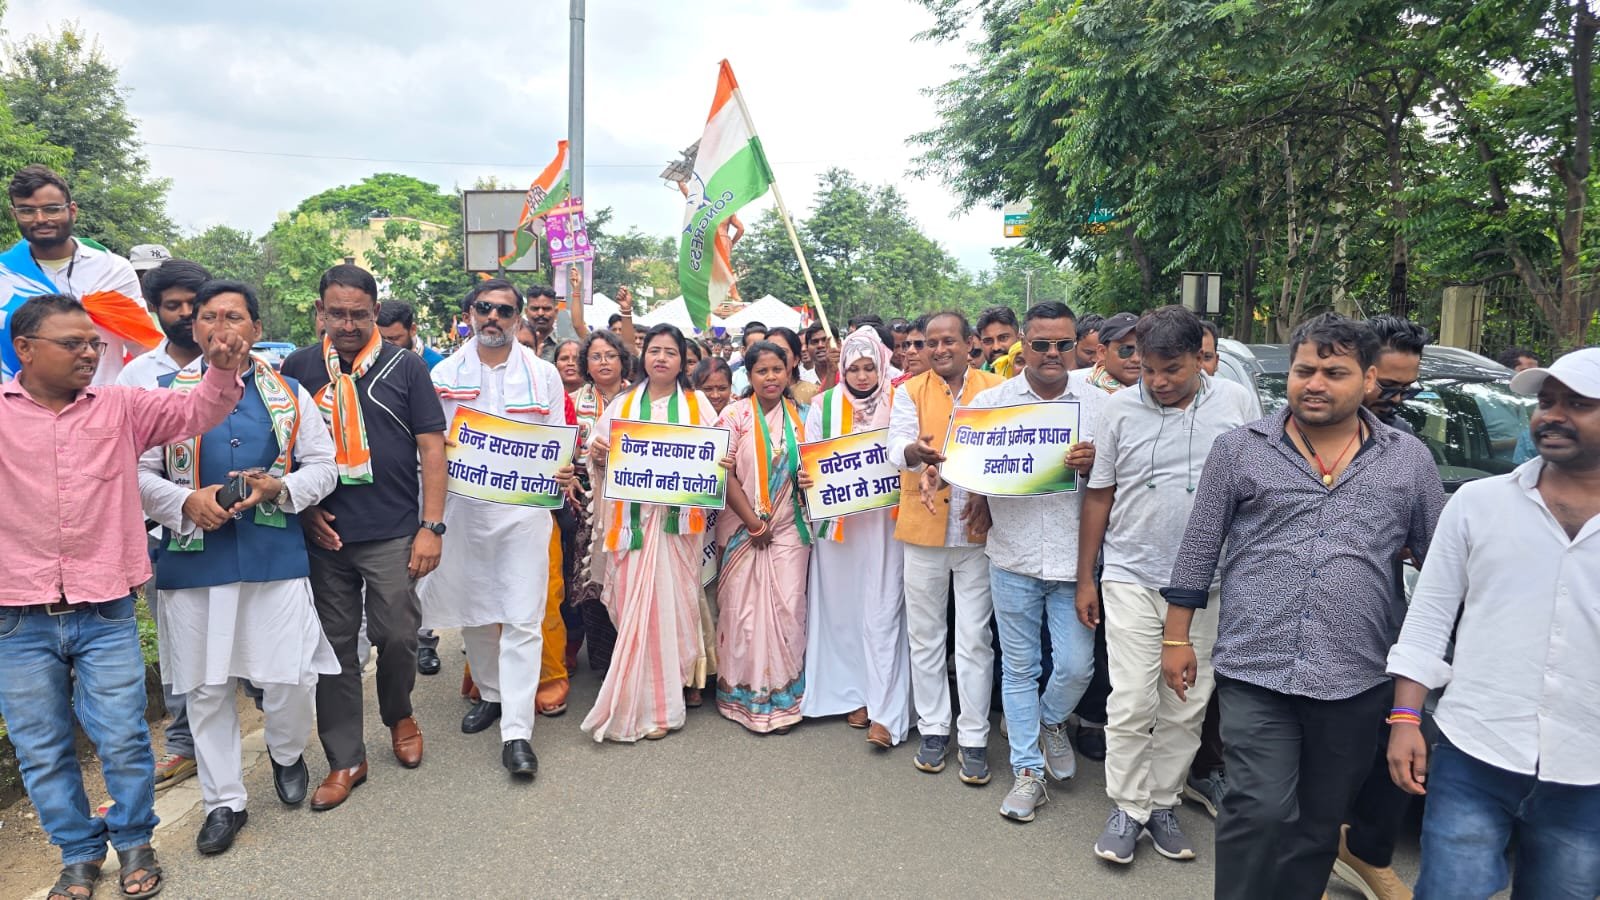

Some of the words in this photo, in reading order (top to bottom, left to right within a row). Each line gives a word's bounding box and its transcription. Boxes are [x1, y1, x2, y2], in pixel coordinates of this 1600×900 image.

[458, 422, 488, 450] केन्द्र
[489, 435, 539, 459] सरकार
[541, 440, 561, 461] की
[621, 434, 650, 457] केन्द्र
[651, 441, 697, 460] सरकार
[699, 441, 716, 462] की
[955, 426, 985, 446] शिक्षा
[986, 427, 1007, 446] मंत्री
[1038, 428, 1072, 445] प्रधान
[447, 459, 488, 486] धांधली
[490, 470, 518, 491] नही
[818, 452, 862, 475] नरेन्द्र
[1022, 453, 1034, 474] दो
[614, 467, 654, 489] धांधली
[655, 471, 680, 491] नही
[682, 473, 718, 495] चलेगी
[819, 484, 851, 506] होश
[853, 477, 869, 497] मे
[872, 469, 901, 494] आय
